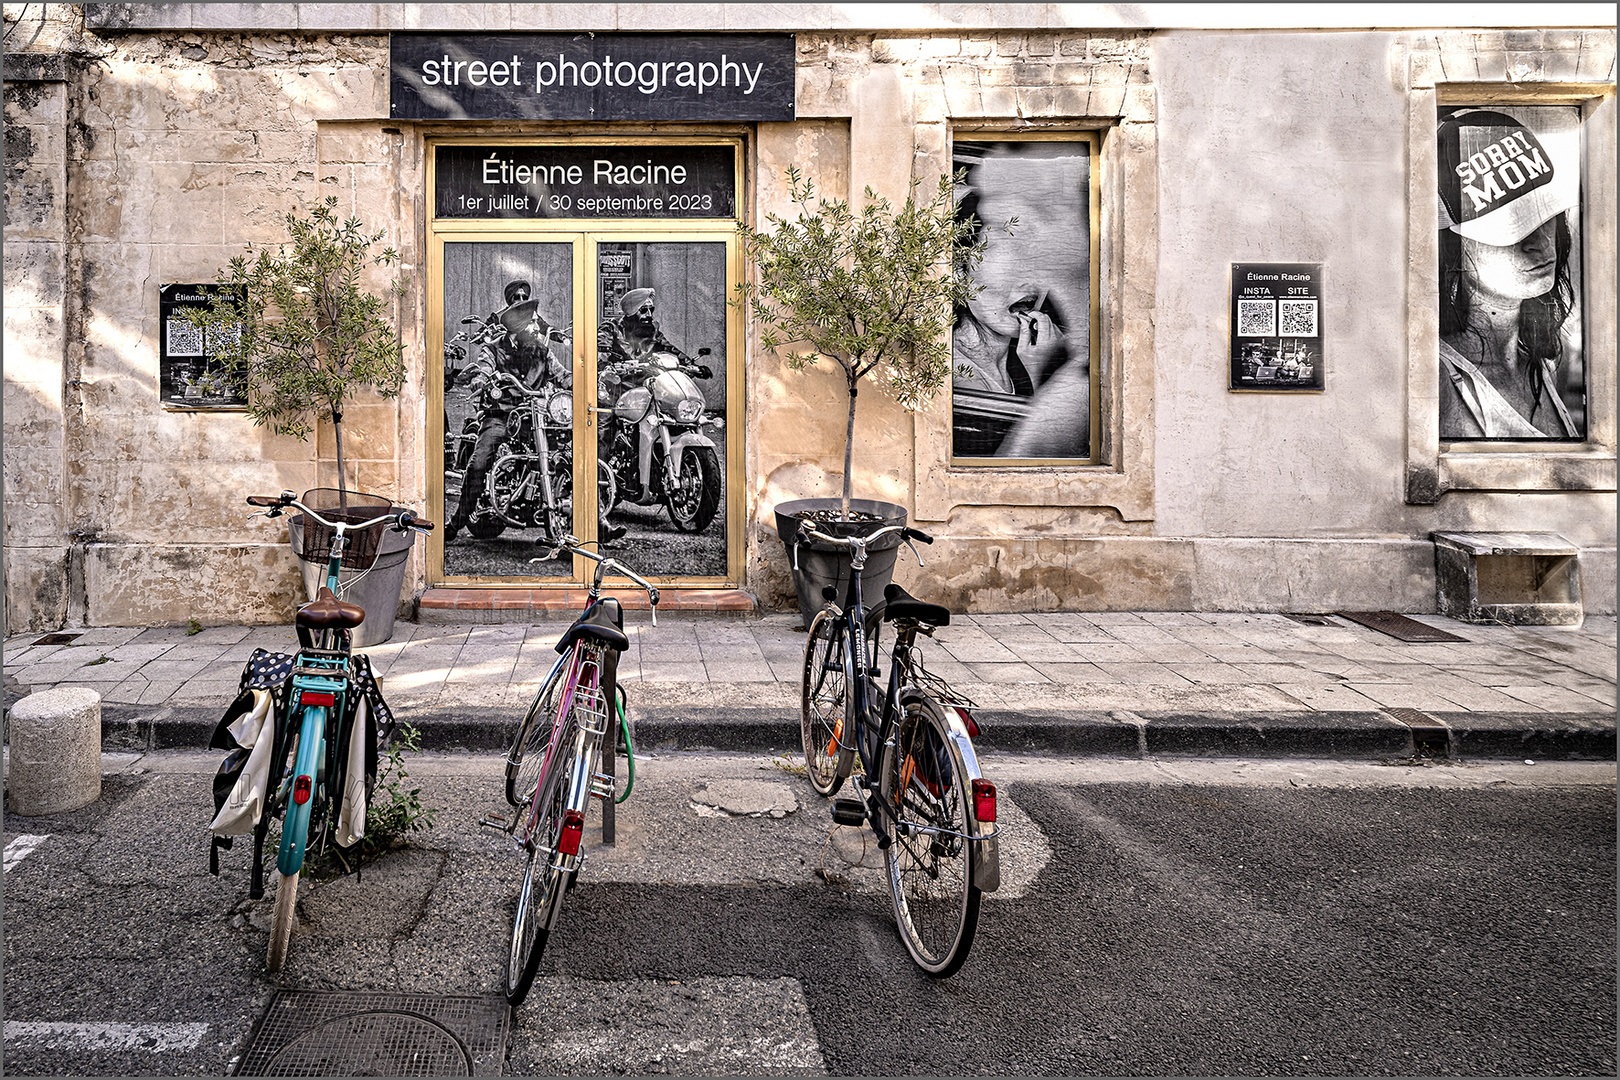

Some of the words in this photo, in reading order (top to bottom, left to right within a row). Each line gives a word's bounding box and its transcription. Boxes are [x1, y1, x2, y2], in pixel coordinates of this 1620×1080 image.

[421, 54, 522, 87] street
[536, 53, 764, 95] photography
[482, 152, 583, 185] Étienne
[593, 159, 687, 185] Racine
[1455, 130, 1534, 185] SORRY
[1462, 147, 1550, 213] MOM
[458, 194, 484, 211] 1er
[487, 194, 530, 213] juillet
[535, 194, 545, 213] /
[549, 194, 573, 211] 30
[577, 194, 664, 216] septembre
[668, 194, 713, 211] 2023
[1247, 272, 1279, 281] Étienne
[1281, 272, 1311, 281] Racine
[175, 292, 205, 301] Étienne
[207, 293, 235, 301] Rine
[1244, 287, 1271, 295] INSTA
[1287, 287, 1309, 295] SITE
